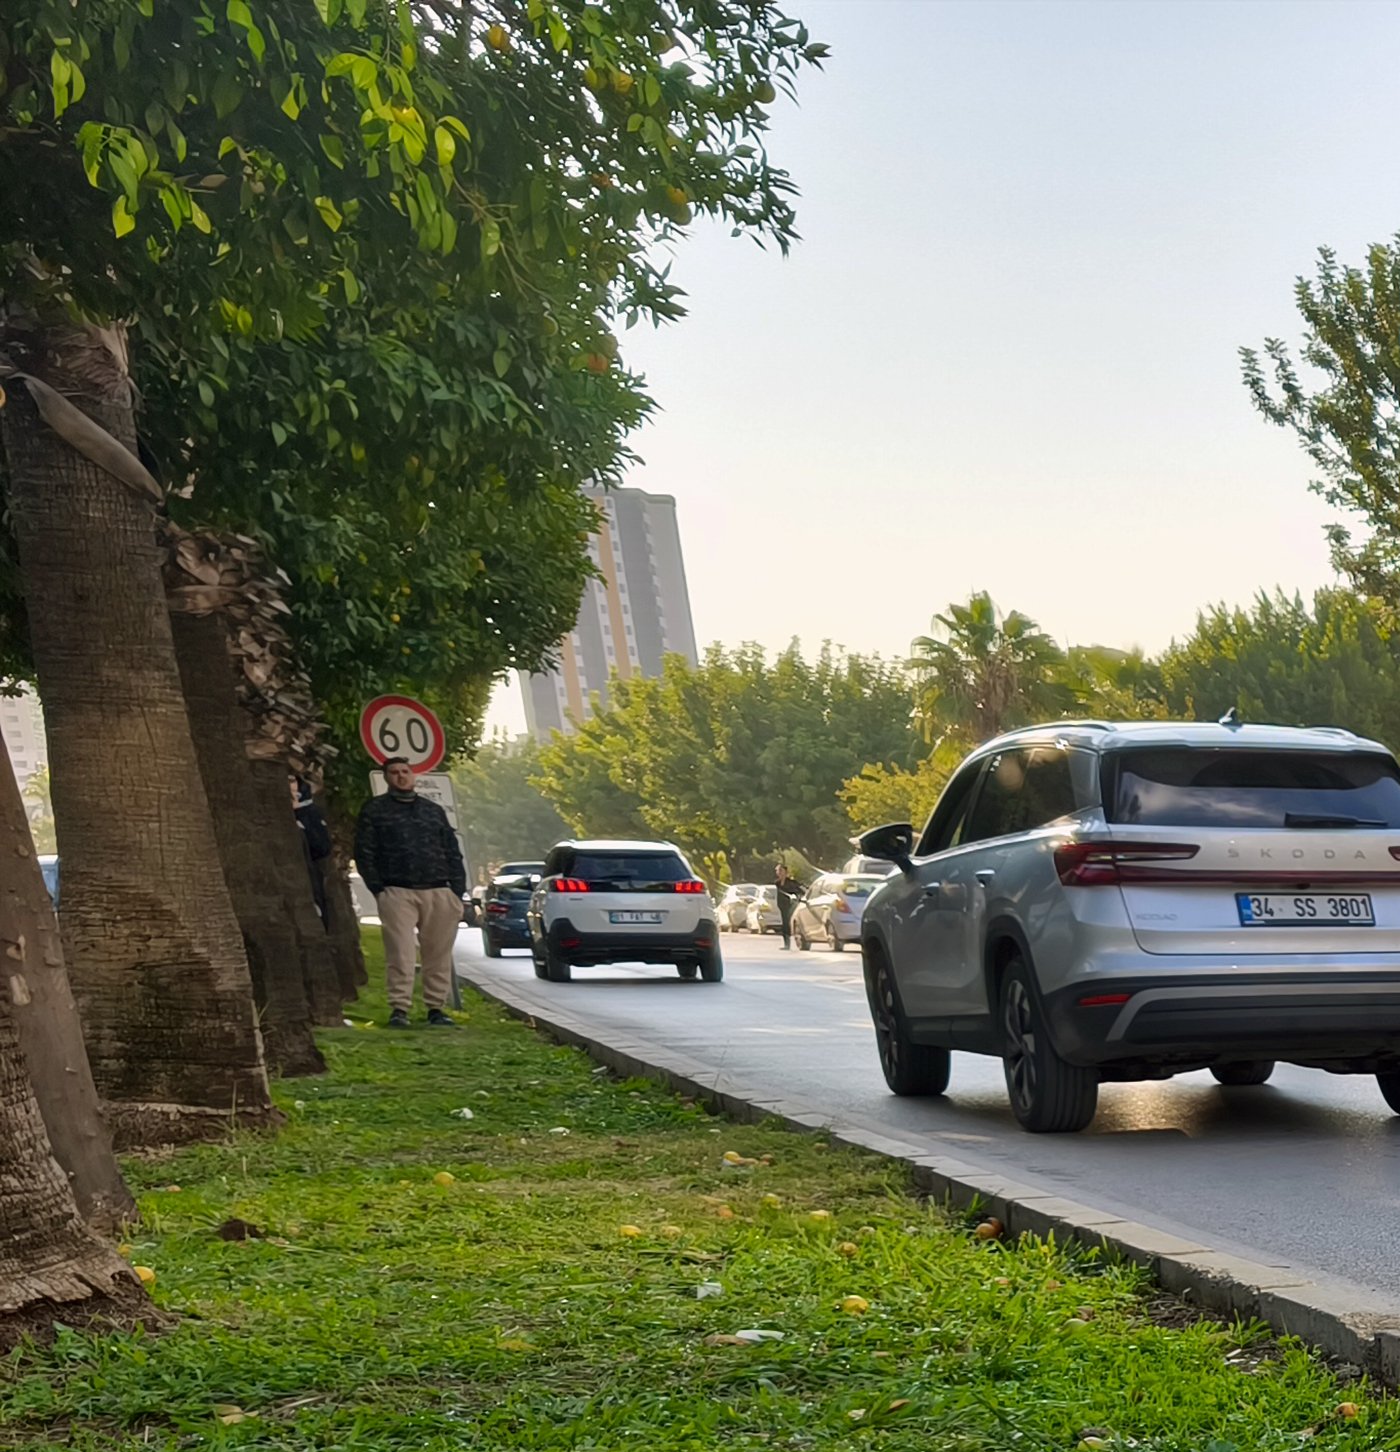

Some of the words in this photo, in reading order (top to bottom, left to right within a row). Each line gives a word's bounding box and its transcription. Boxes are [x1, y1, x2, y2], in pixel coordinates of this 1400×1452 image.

[379, 718, 428, 753] 60
[1227, 848, 1367, 860] SKODA
[1250, 898, 1274, 917] 34
[1295, 898, 1317, 917] SS
[1327, 898, 1371, 917] 3801
